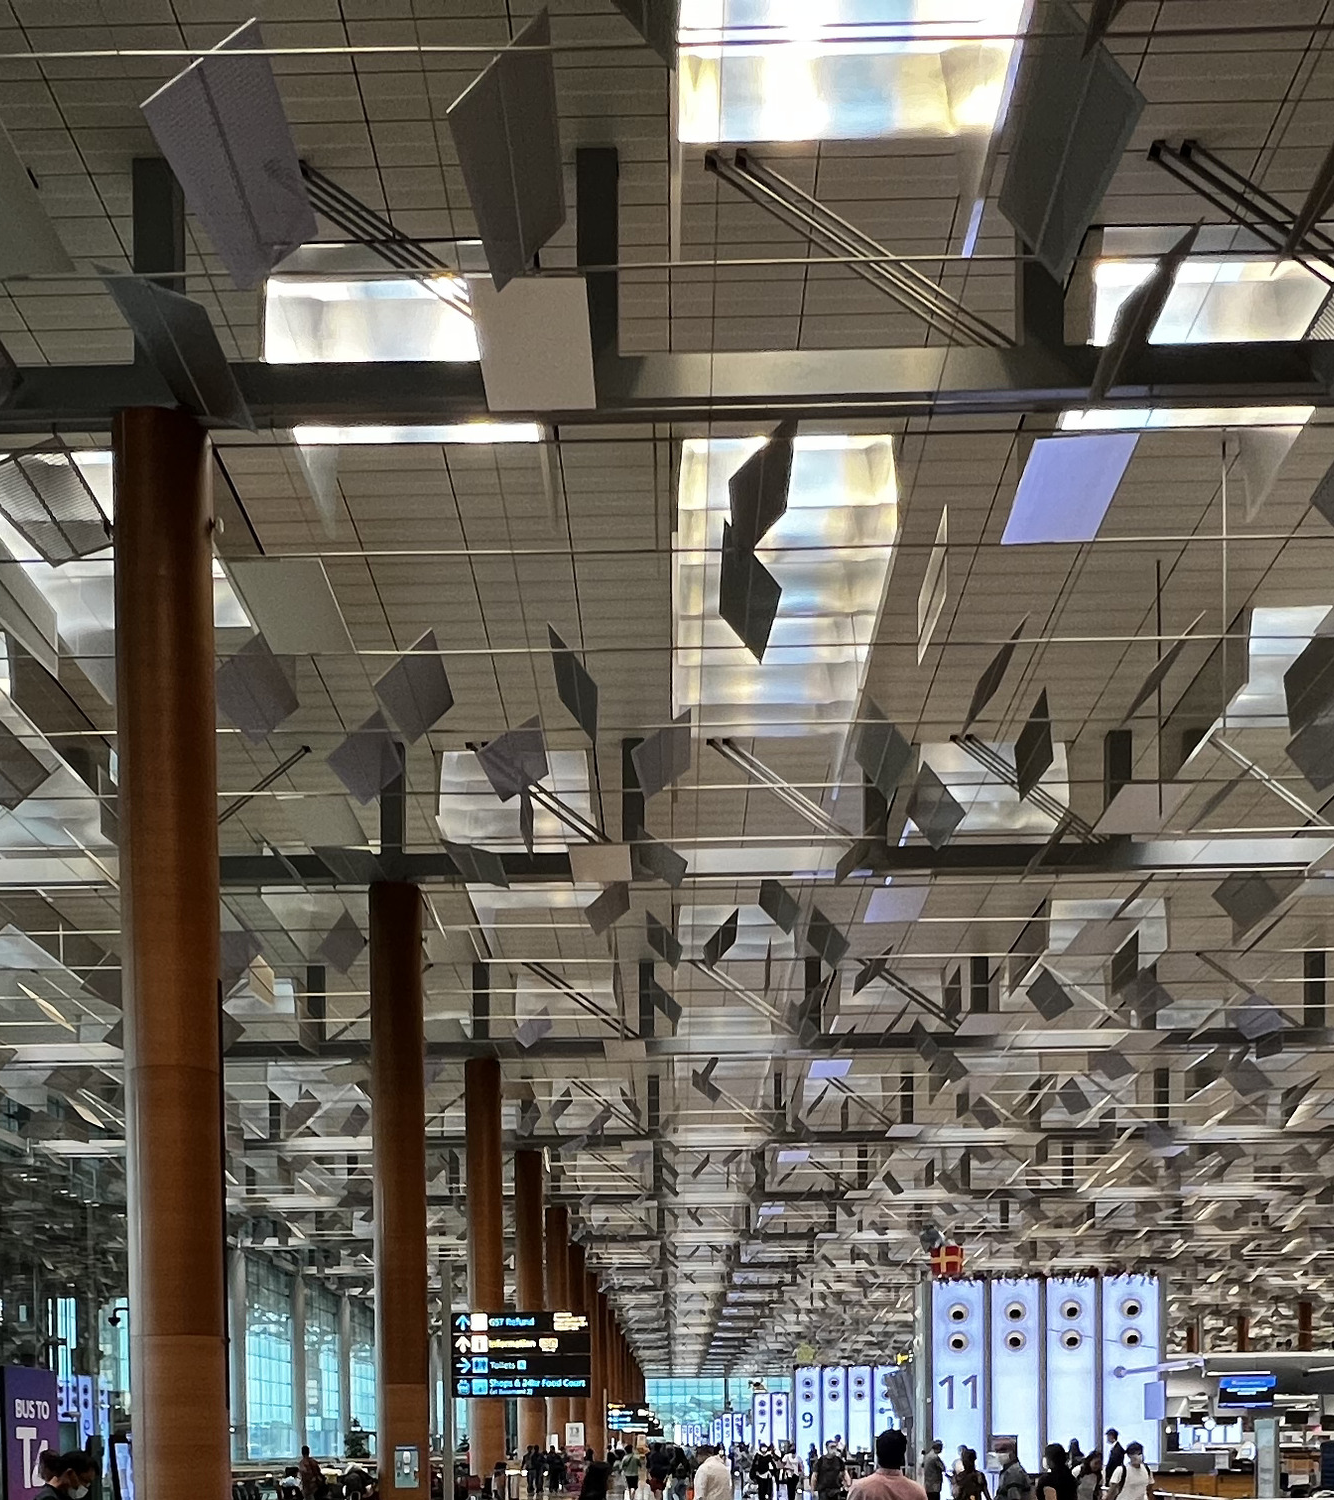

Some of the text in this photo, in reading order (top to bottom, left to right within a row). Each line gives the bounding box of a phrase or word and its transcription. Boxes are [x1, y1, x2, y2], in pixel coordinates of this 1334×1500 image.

[505, 1316, 535, 1327] Refund
[938, 1375, 978, 1410] 11
[14, 1399, 50, 1420] BUS TO
[758, 1422, 767, 1434] 7
[802, 1411, 814, 1429] 9
